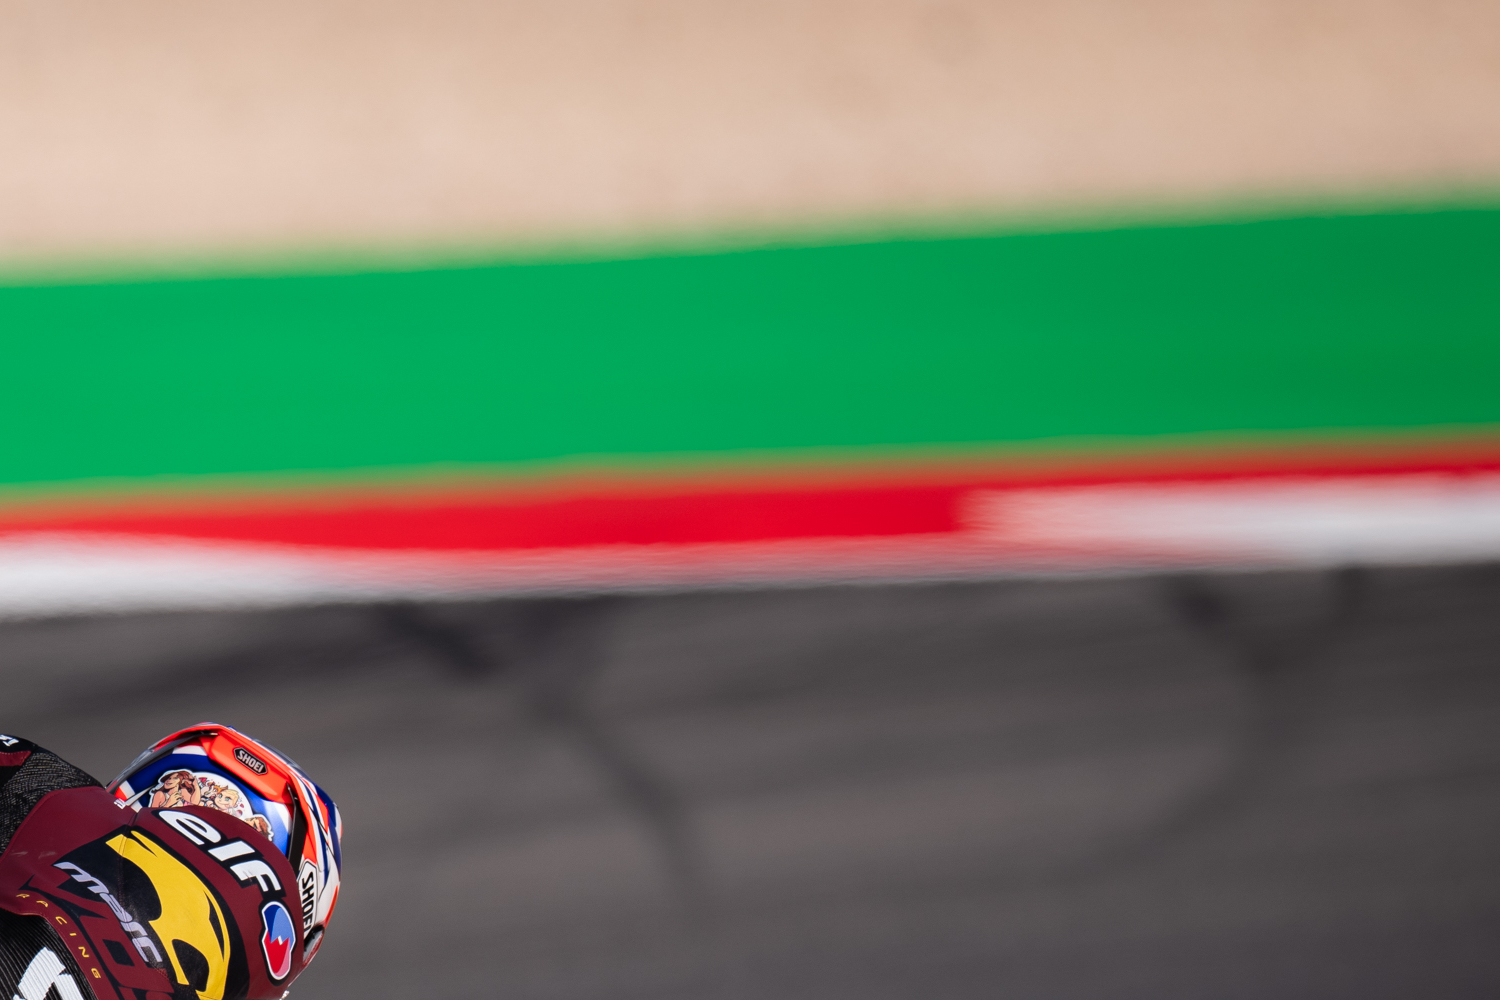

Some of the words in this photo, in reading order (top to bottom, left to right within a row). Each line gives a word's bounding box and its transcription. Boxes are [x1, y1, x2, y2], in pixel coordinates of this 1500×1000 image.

[237, 749, 265, 773] SHOEI
[158, 810, 282, 892] elf
[15, 892, 102, 979] RACING
[52, 861, 163, 963] marc
